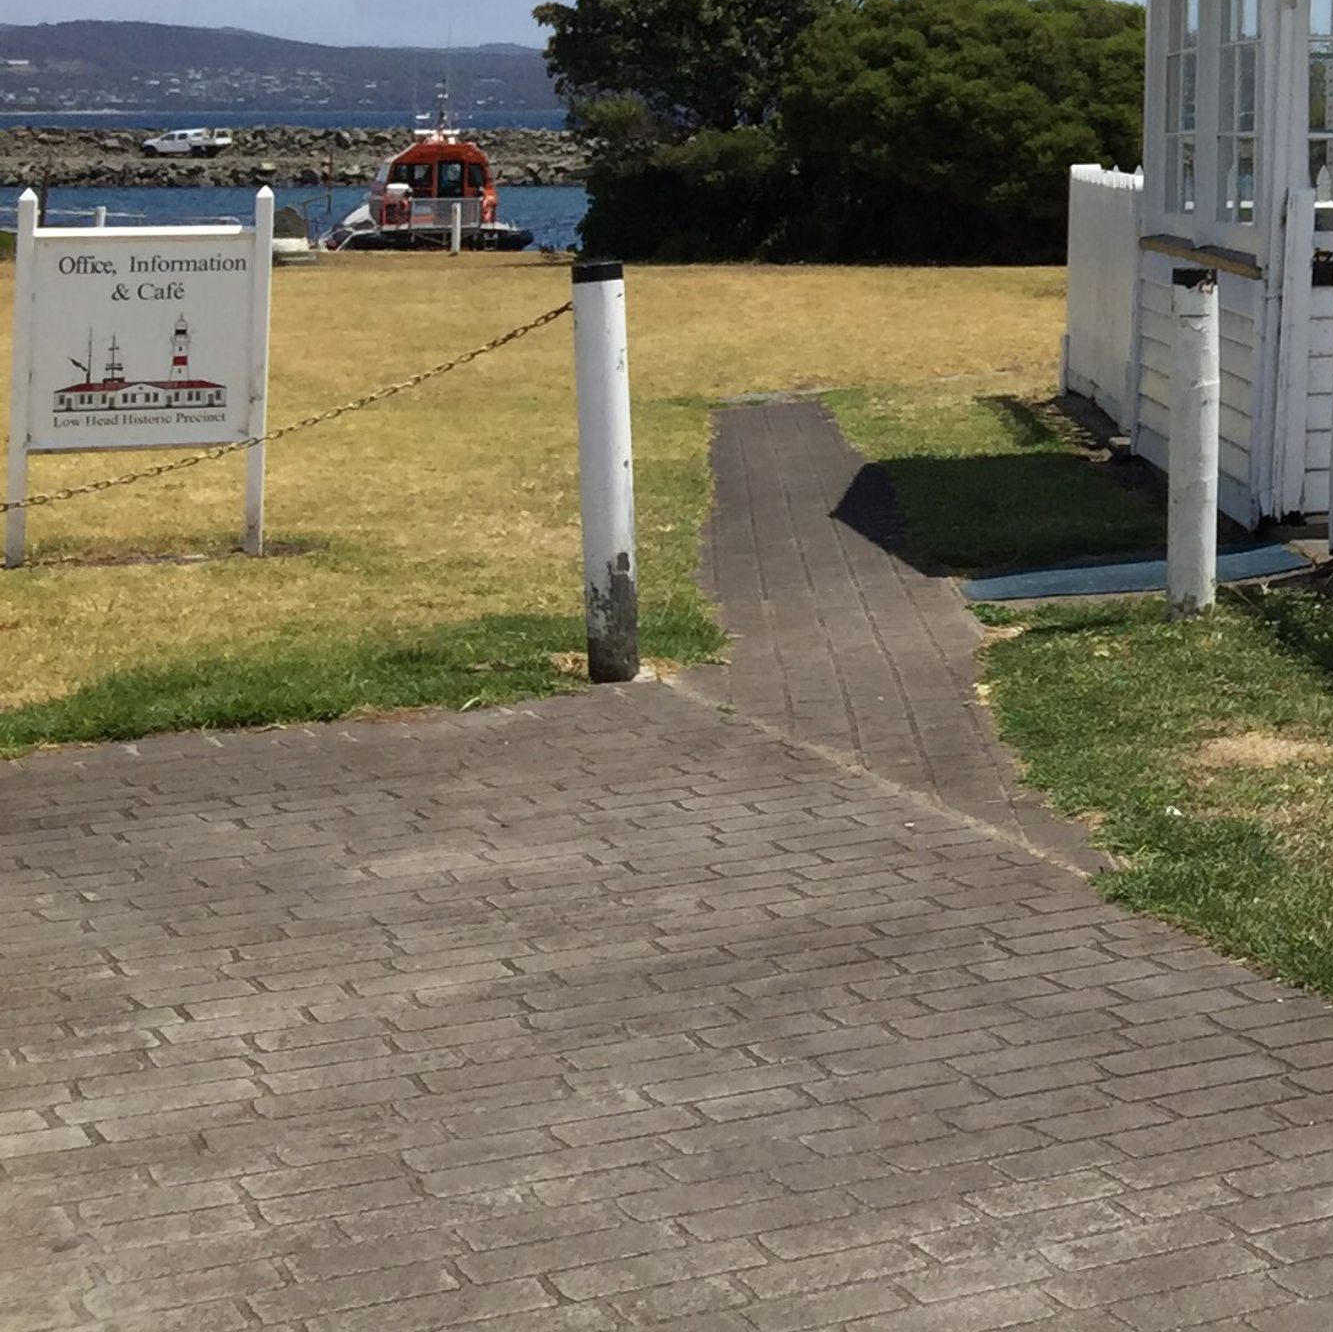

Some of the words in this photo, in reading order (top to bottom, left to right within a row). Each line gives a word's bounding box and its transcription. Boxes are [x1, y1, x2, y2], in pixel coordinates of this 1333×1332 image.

[58, 256, 117, 275] Office,
[129, 253, 247, 273] Information
[111, 283, 130, 301] &
[137, 282, 185, 300] Café
[53, 416, 80, 428] Low
[86, 415, 118, 427] Head
[123, 414, 171, 425] Historic
[176, 412, 226, 423] Precinct
